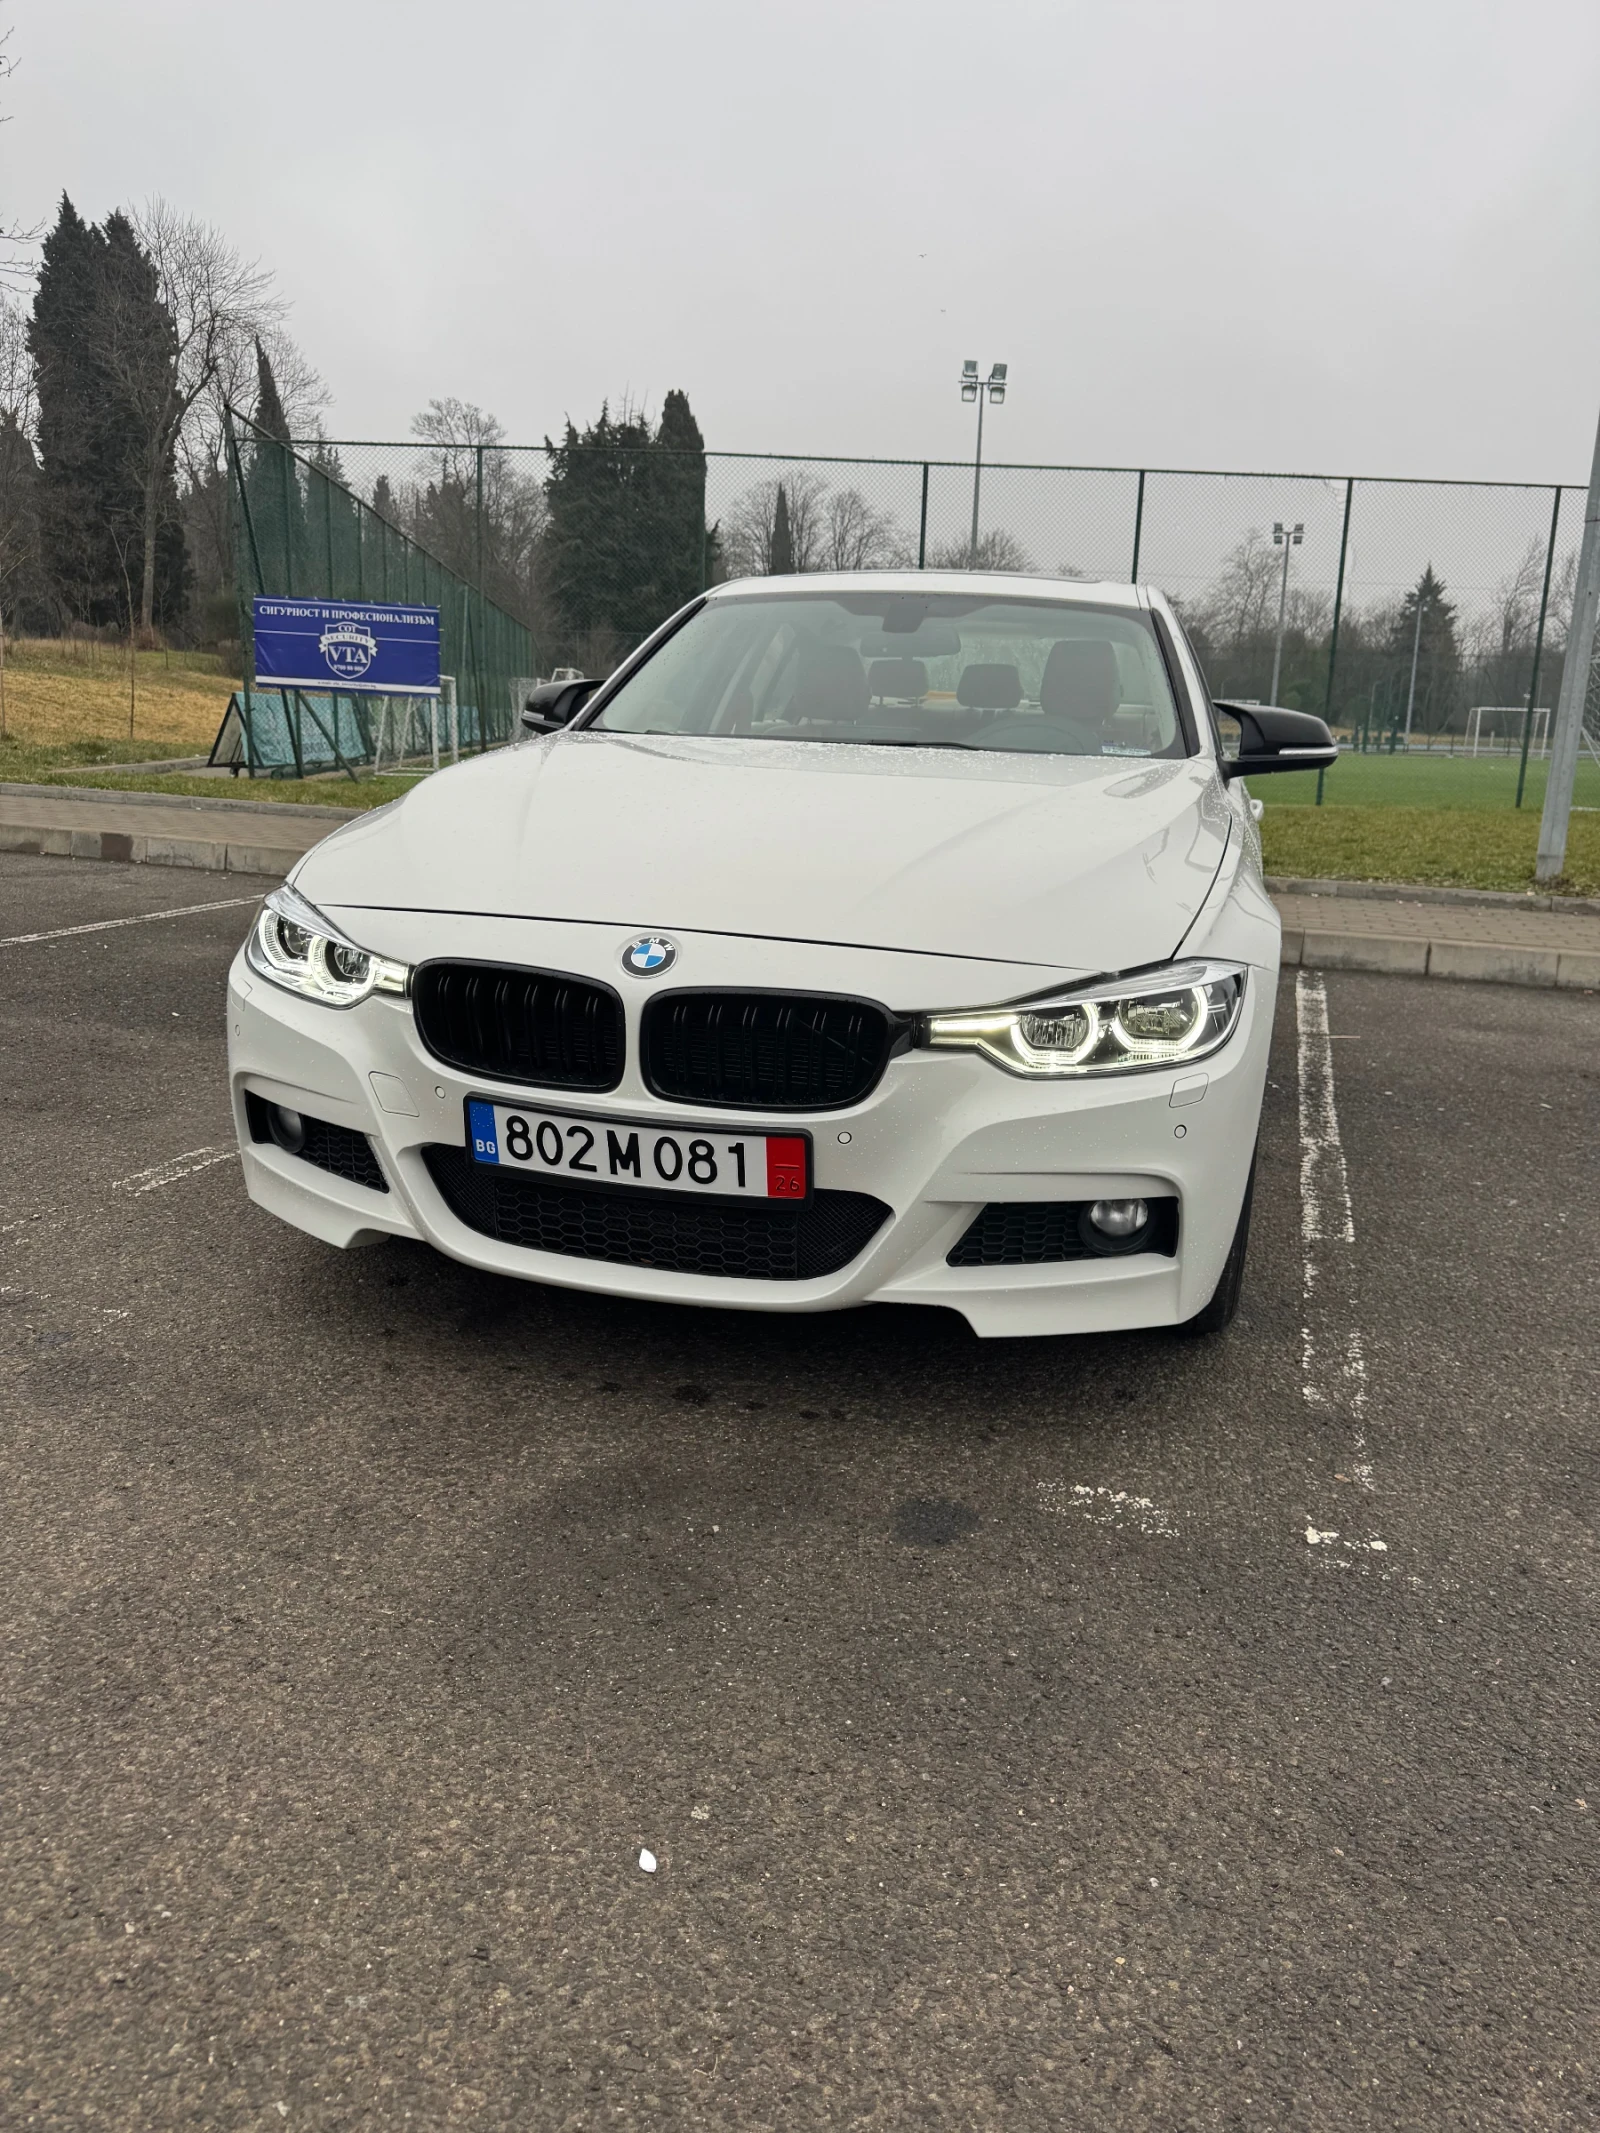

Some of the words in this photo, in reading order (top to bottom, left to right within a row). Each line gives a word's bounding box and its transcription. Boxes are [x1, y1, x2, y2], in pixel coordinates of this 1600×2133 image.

[259, 605, 320, 618] СИГУРНОСТ
[322, 609, 330, 618] И
[331, 609, 435, 626] ПРОФЕСИОНАЛИЗЪМ
[328, 645, 368, 664] VTA
[632, 937, 675, 951] BMW
[475, 1139, 496, 1155] BG
[506, 1115, 598, 1173] 802
[653, 1136, 747, 1188] 081
[775, 1174, 800, 1192] 26
